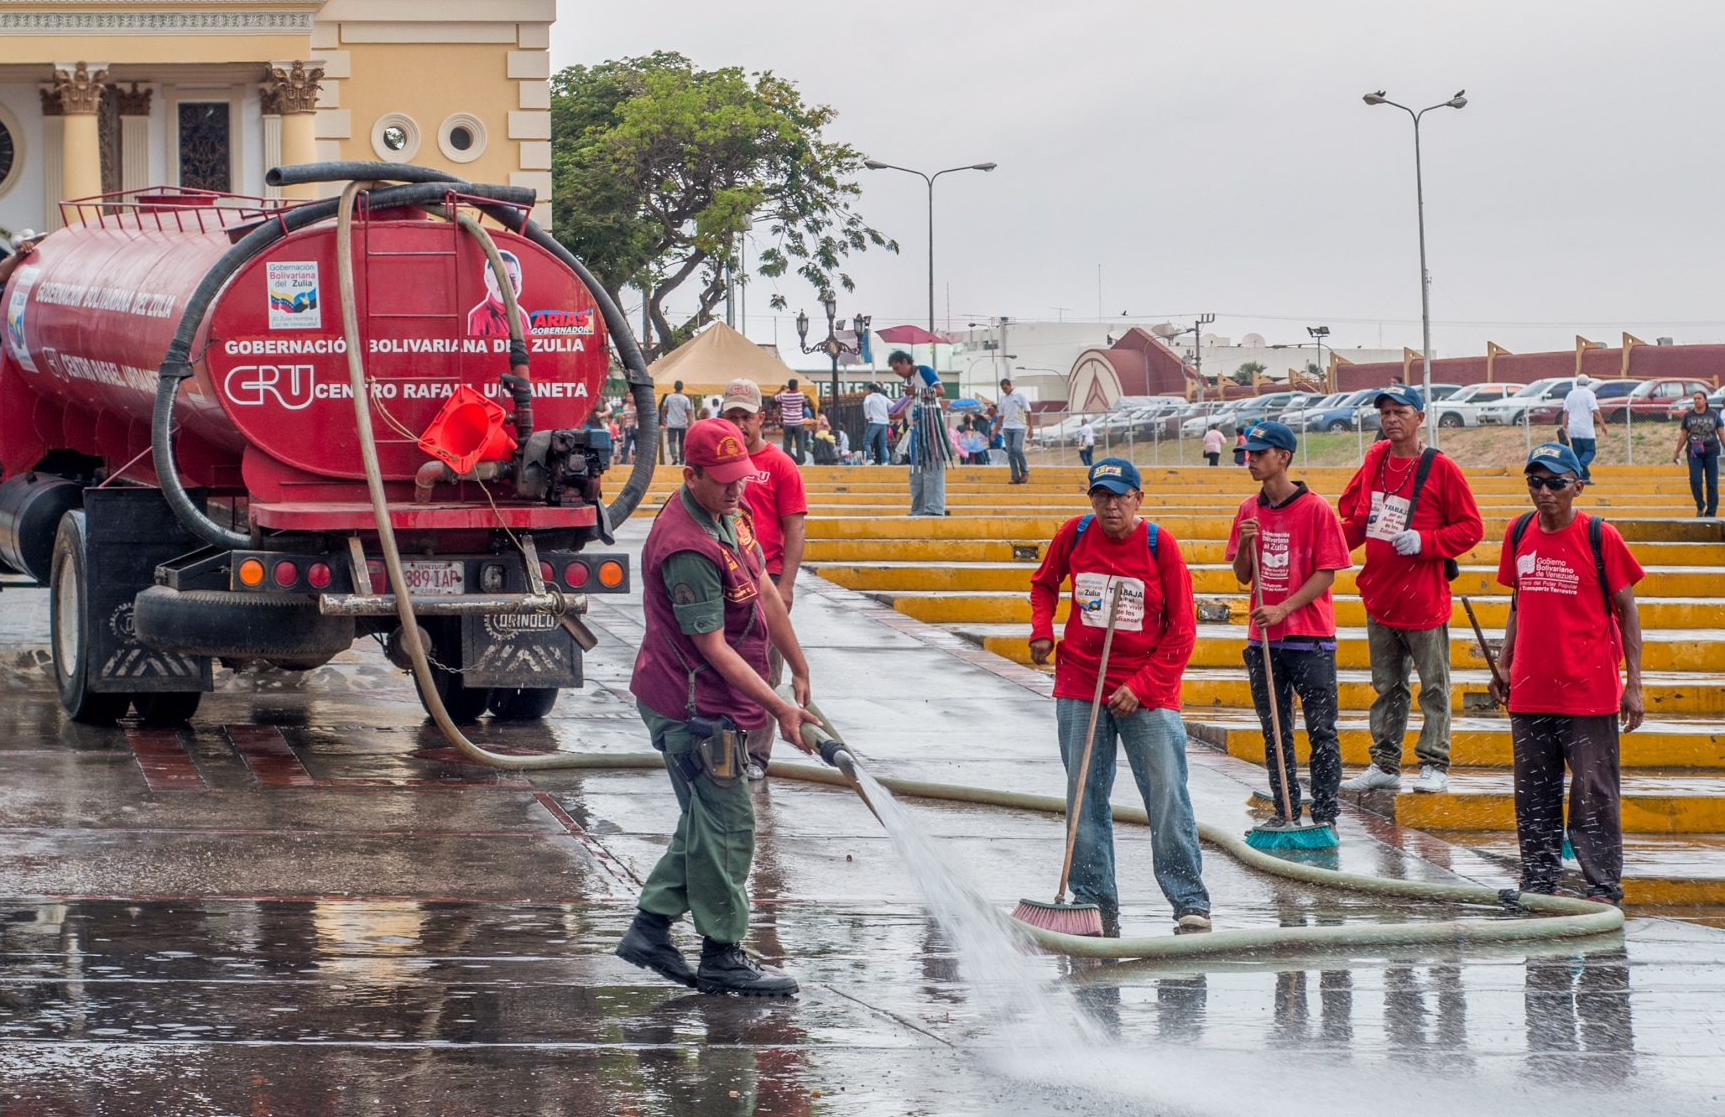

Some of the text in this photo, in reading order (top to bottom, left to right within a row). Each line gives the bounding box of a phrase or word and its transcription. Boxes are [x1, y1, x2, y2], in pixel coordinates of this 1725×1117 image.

[269, 263, 315, 272] Gobernación
[270, 272, 316, 280] Bolivariana
[275, 279, 313, 288] del Zulia
[533, 312, 590, 327] ARIAS
[531, 325, 590, 334] GOBERNADOR
[225, 337, 348, 354] GOBERNACIÓ
[366, 339, 488, 353] BOLIVARIANA
[531, 338, 585, 353] ZULIA
[315, 383, 396, 399] CENRO
[483, 383, 589, 398] URANETA
[1536, 557, 1567, 567] Gobierno
[1535, 564, 1574, 575] Bolivariano
[405, 569, 459, 588] 389 IAP
[1546, 571, 1580, 582] Venezuela
[1084, 589, 1101, 597] Zulia
[499, 614, 555, 628] ORINOCO
[1115, 616, 1140, 624] ulianos!
